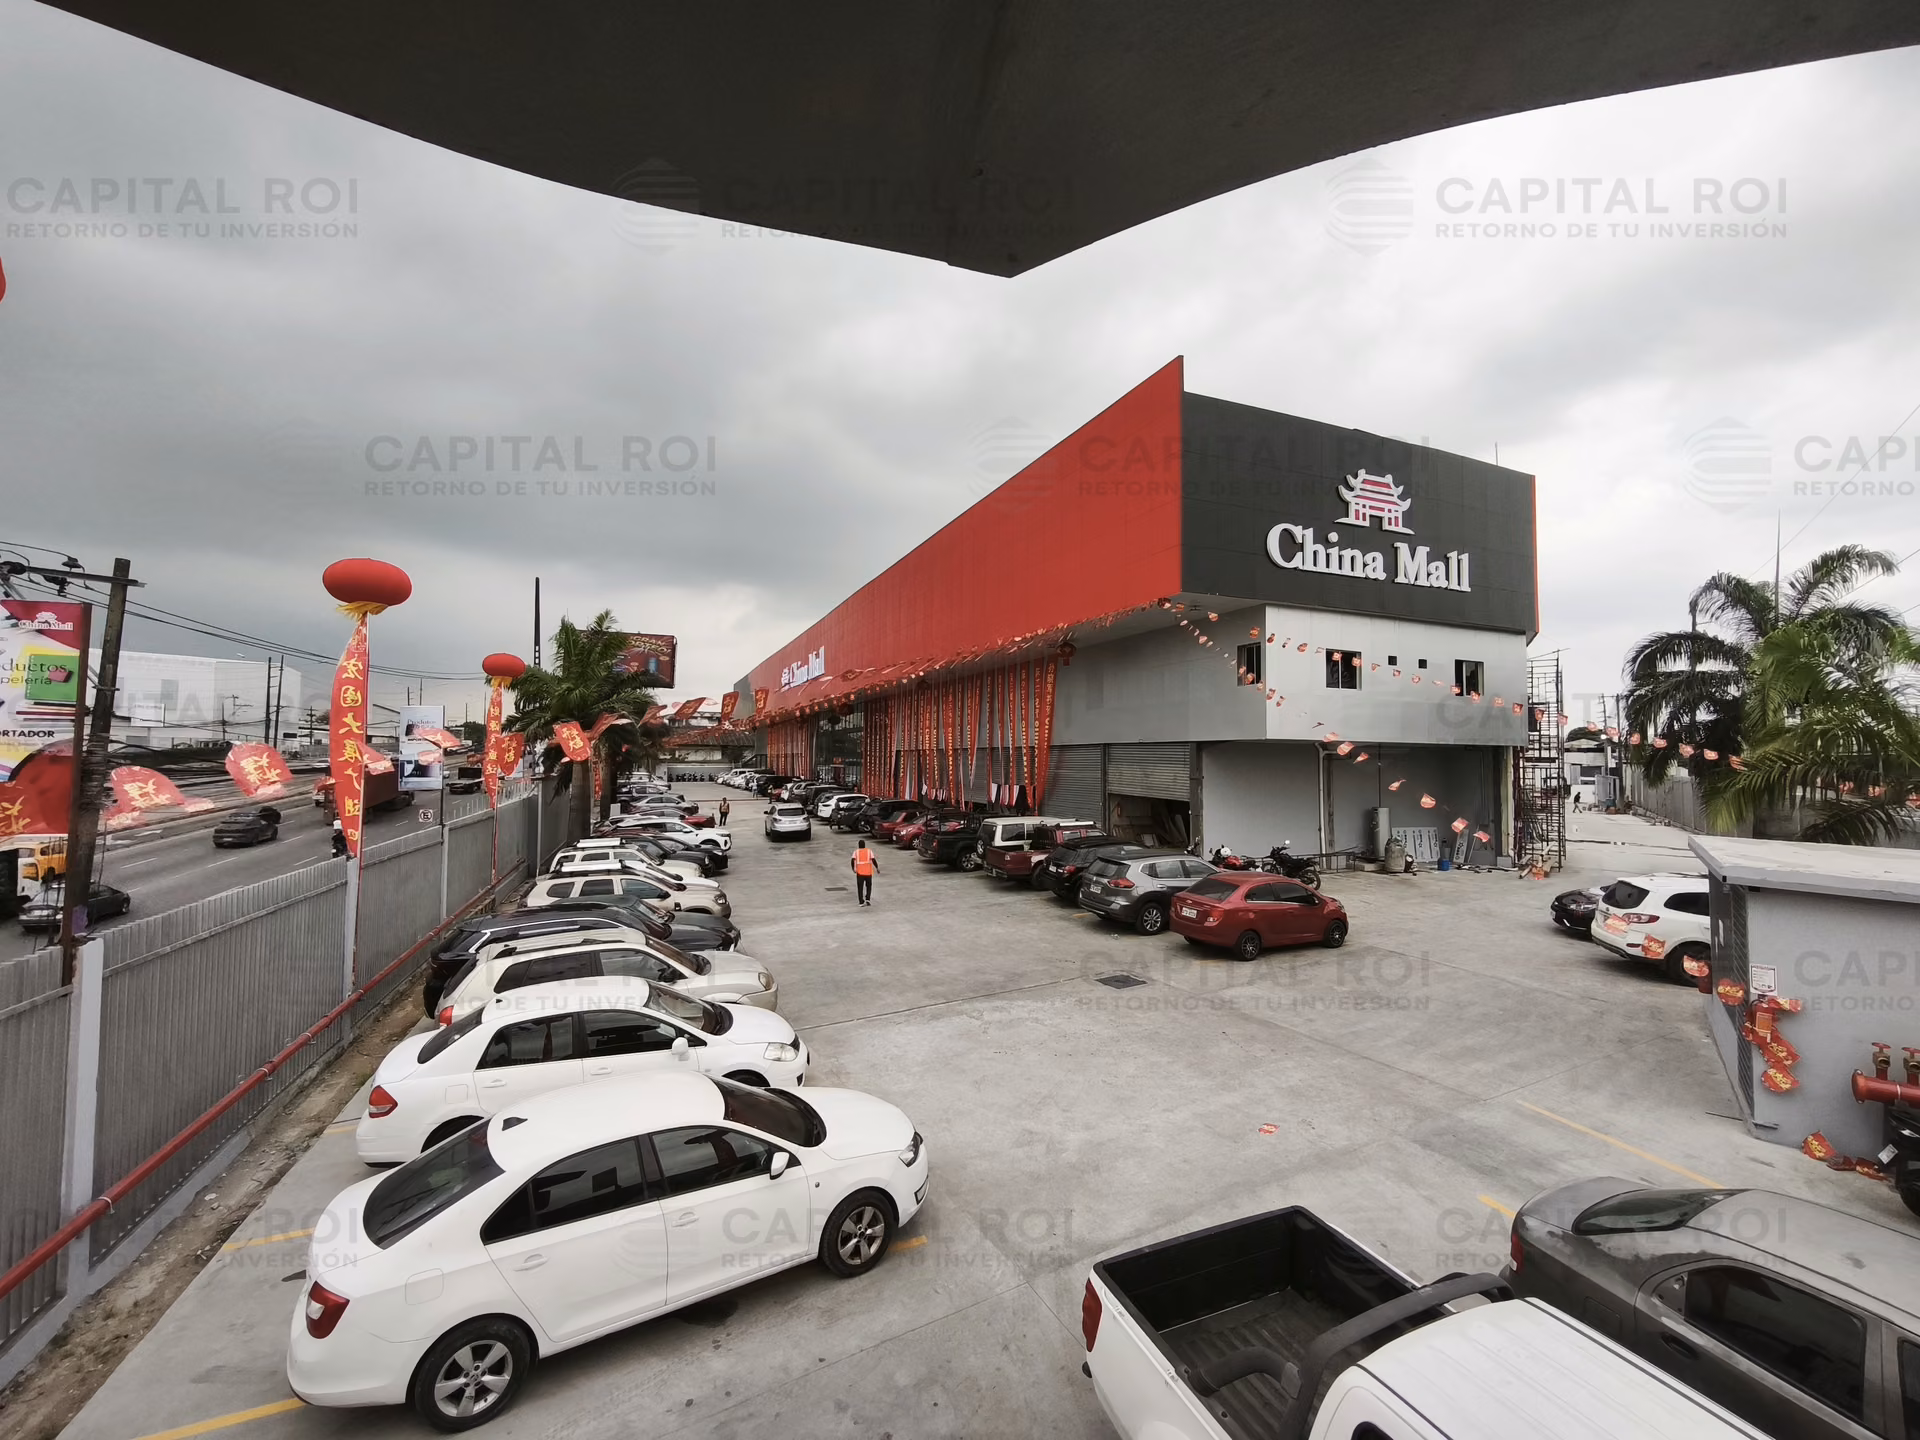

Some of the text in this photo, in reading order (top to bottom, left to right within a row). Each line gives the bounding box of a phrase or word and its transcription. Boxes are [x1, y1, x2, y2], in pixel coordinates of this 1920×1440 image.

[1266, 523, 1472, 592] China Mall
[626, 639, 672, 655] ORTEO!
[0, 657, 68, 672] ductos
[0, 729, 56, 739] RTADOR
